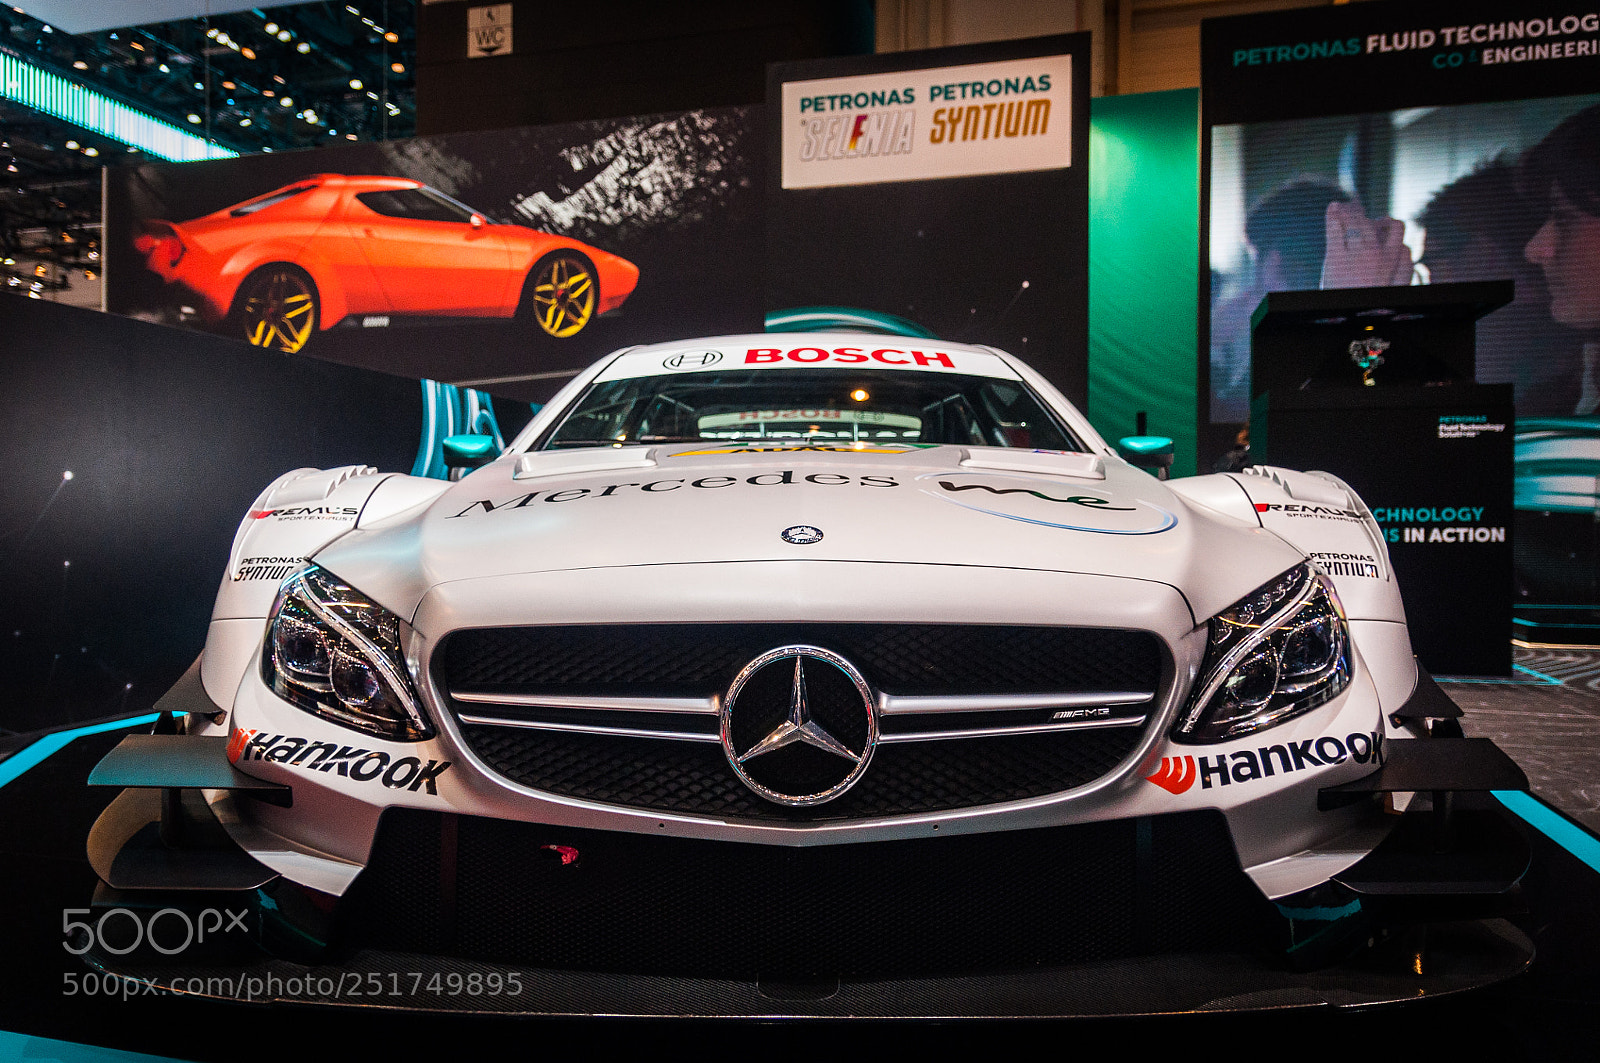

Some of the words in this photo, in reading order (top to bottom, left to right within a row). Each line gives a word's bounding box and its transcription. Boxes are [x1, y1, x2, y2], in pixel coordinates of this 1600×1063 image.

[474, 27, 505, 46] WC
[1232, 37, 1361, 67] PETRONAS
[1366, 29, 1436, 54] FLUID
[1440, 13, 1600, 46] TECHNOLOG
[1481, 39, 1600, 65] ENGINEERI
[929, 74, 1051, 102] PETRONAS
[800, 88, 915, 113] PETRONAS
[929, 99, 1051, 144] SYNTIUM
[800, 109, 916, 162] SELENIA
[744, 347, 956, 368] BOSCH
[445, 470, 899, 519] Mercedes
[266, 507, 358, 517] REMUS
[1266, 504, 1362, 518] REMUS
[1372, 507, 1484, 522] CHNOLOGY
[1404, 527, 1425, 542] IN
[1428, 527, 1505, 542] ACTION
[241, 556, 303, 565] PETRONAS
[1310, 552, 1374, 562] PETRONAS
